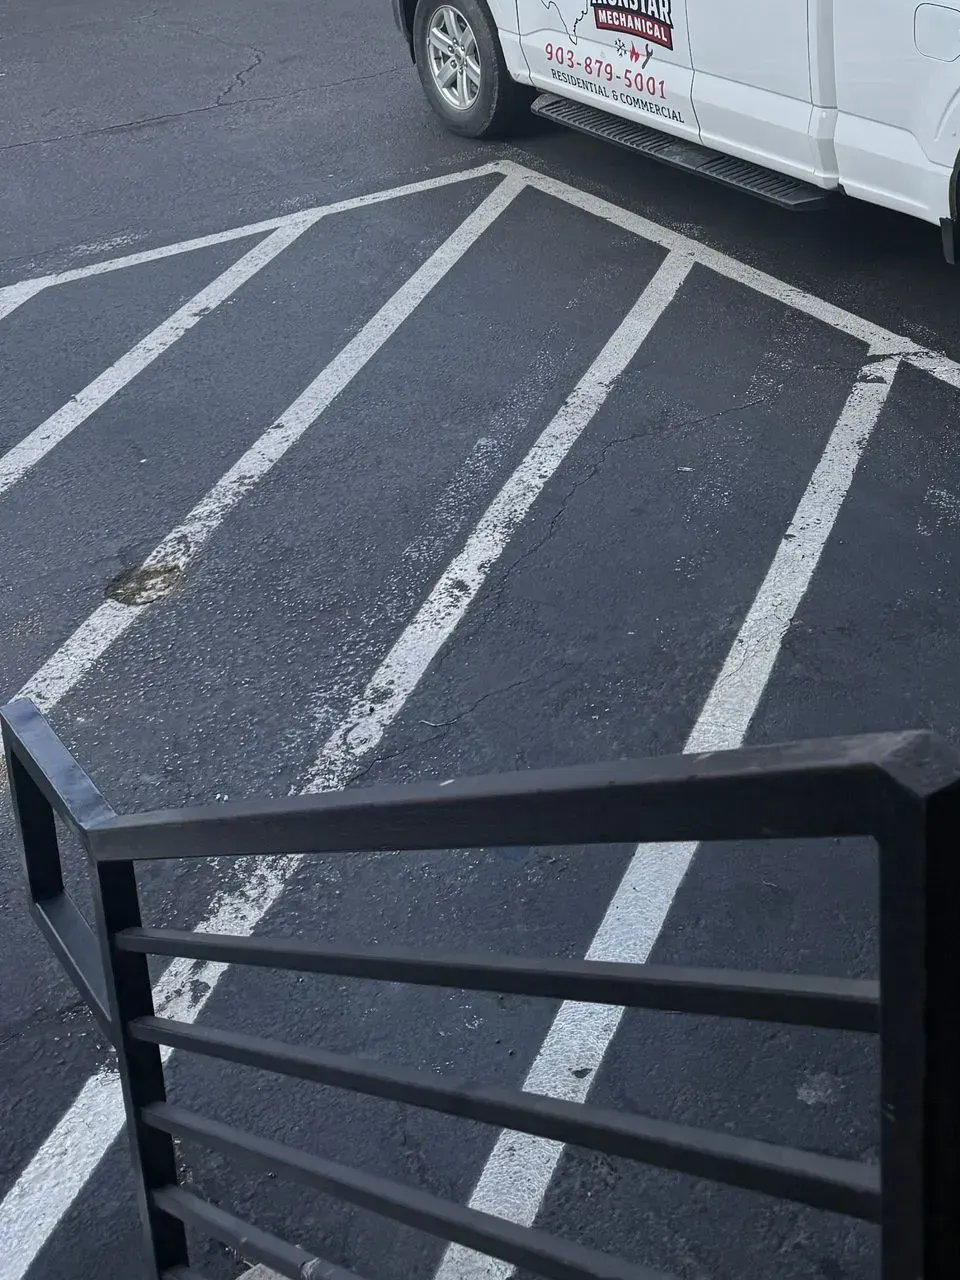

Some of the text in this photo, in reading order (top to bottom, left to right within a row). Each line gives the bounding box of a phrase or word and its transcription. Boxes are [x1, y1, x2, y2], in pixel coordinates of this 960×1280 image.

[598, 9, 668, 42] MECHANICAL
[545, 43, 667, 100] 903-879-5001
[551, 68, 685, 124] RESIDENTIAL & COMMERCIAL
